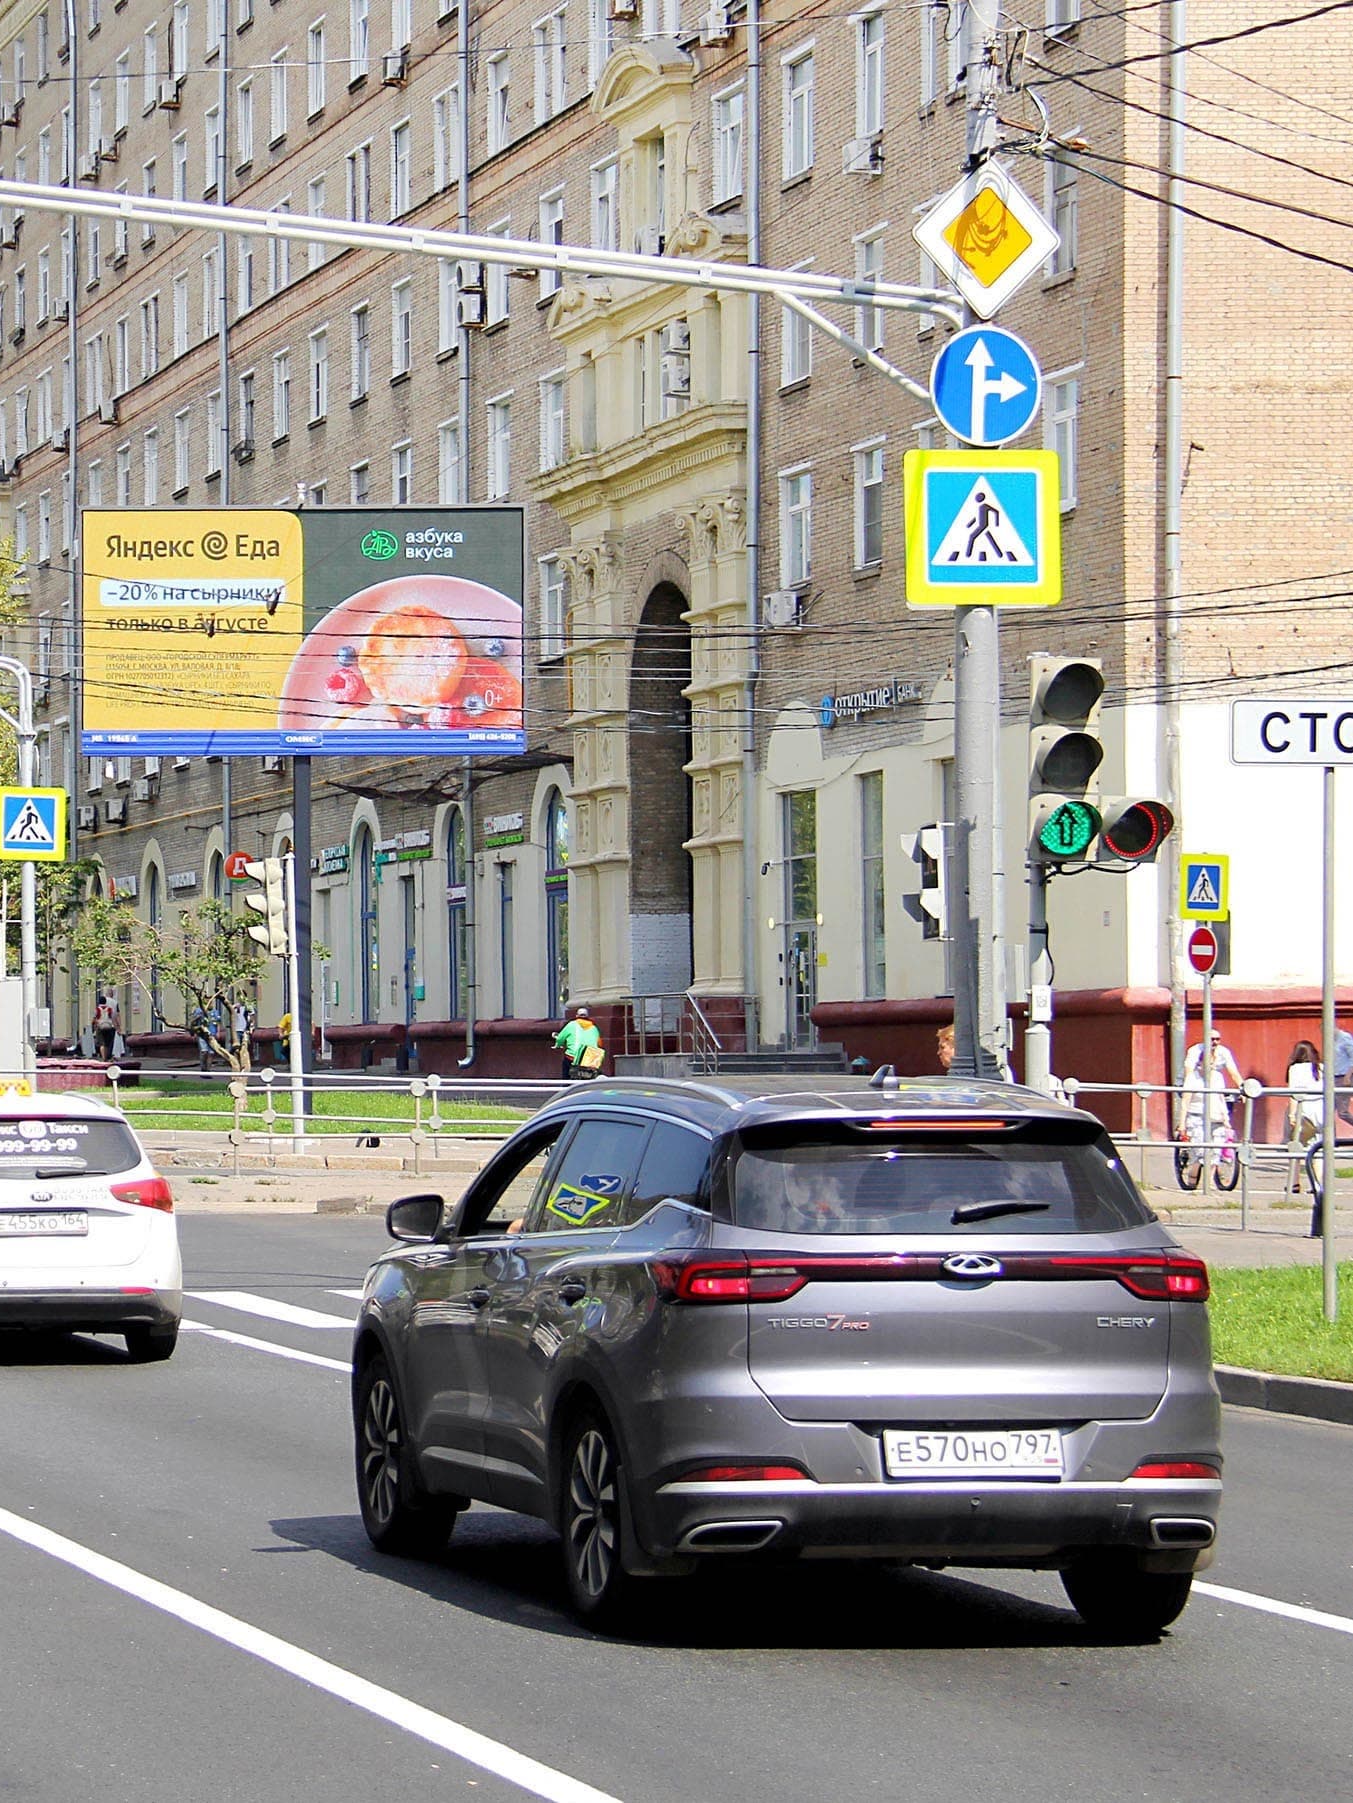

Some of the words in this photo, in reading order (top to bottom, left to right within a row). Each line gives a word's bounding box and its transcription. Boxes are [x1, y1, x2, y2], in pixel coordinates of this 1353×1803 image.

[405, 527, 464, 546] азбука
[106, 535, 195, 561] Яндекс
[236, 534, 280, 561] Еда
[405, 546, 454, 562] вкуса
[163, 588, 185, 601] на
[190, 587, 280, 604] сырники
[106, 618, 172, 631] только
[178, 618, 188, 630] в
[484, 689, 503, 707] 0+
[834, 687, 890, 722] открытие
[46, 1122, 89, 1134] Такси
[1096, 1316, 1156, 1329] CHERY
